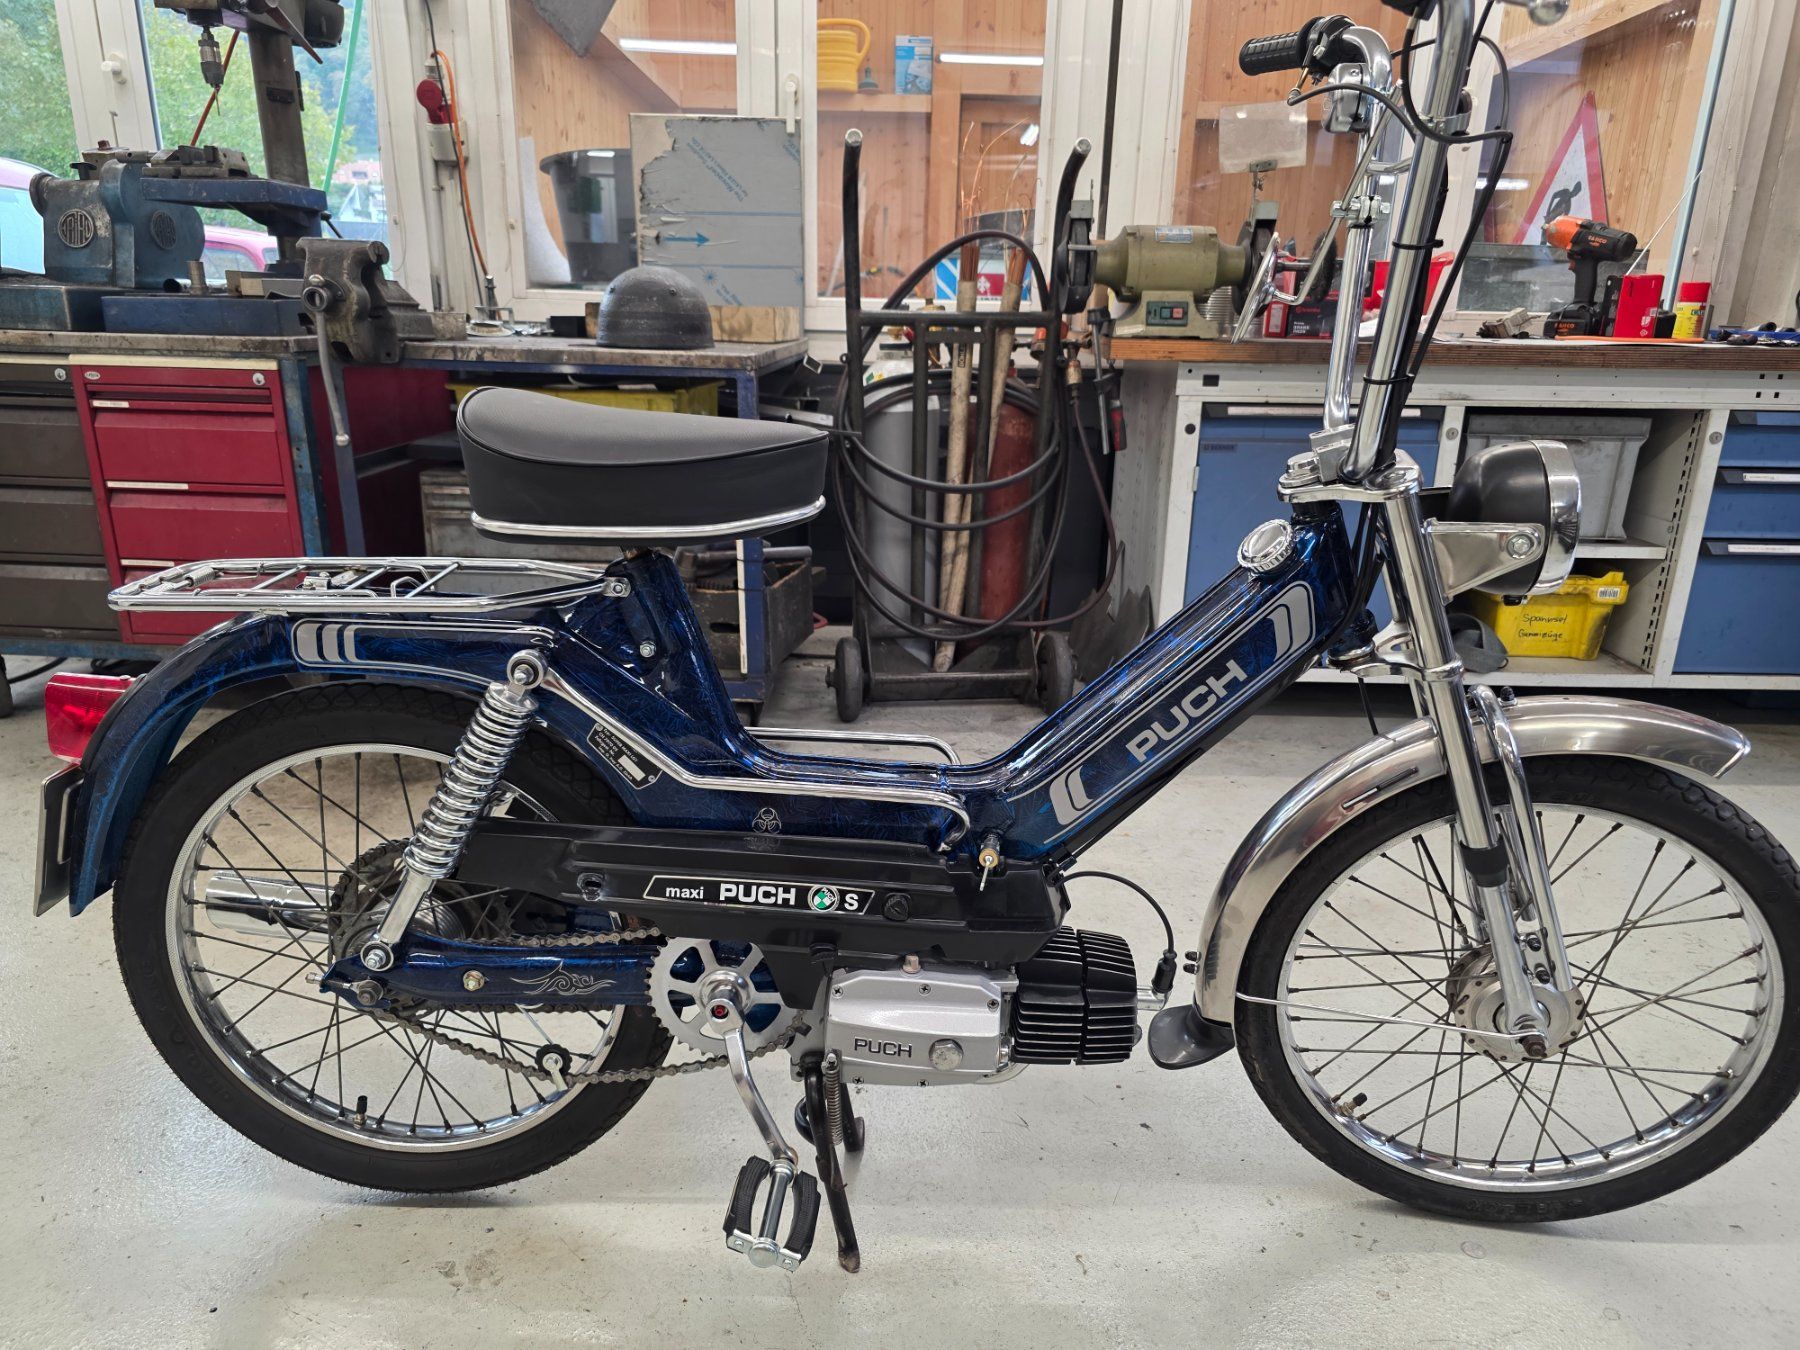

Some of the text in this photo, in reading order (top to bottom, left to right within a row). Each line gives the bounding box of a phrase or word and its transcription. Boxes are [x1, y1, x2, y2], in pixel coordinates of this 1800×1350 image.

[1126, 659, 1248, 762] PUCH
[665, 883, 859, 911] maxi PUCH PUCH S
[854, 1036, 912, 1058] PUCH
